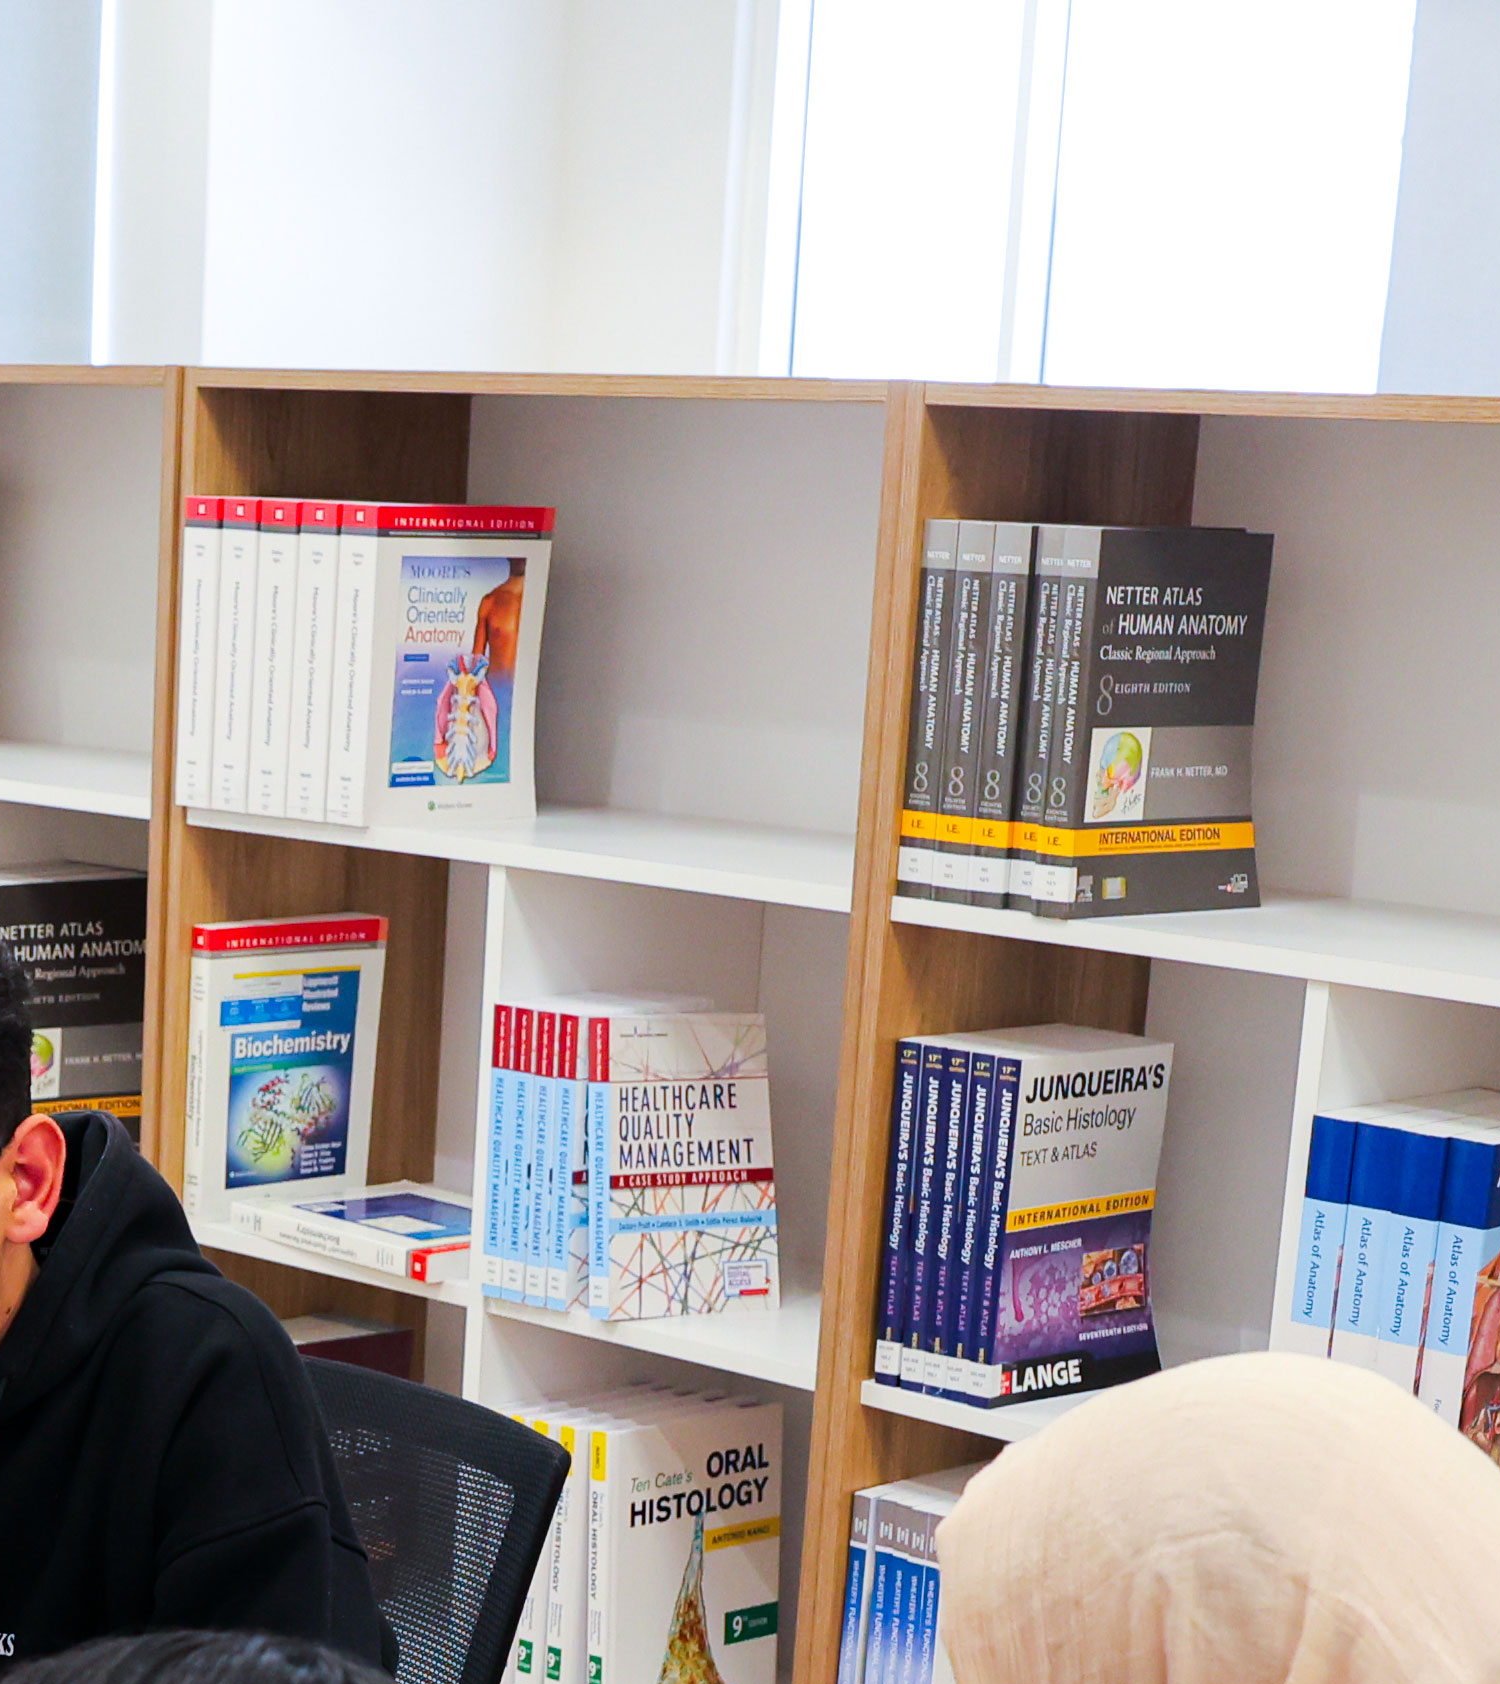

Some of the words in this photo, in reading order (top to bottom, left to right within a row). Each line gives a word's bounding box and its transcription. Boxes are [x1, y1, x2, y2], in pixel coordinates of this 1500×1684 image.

[410, 566, 471, 579] MOORE'S
[407, 587, 468, 607] Clinically
[1106, 586, 1159, 605] NETTER
[1163, 587, 1202, 605] ATLAS
[407, 606, 465, 623] Oriented
[1118, 615, 1174, 635] HUMAN
[1178, 615, 1247, 636] ANATOMY
[405, 626, 465, 647] Anatomy
[1100, 645, 1131, 660] Classic
[1135, 646, 1172, 660] Regional
[1174, 647, 1216, 661] Approach
[1097, 675, 1113, 715] 8
[1115, 682, 1150, 694] EIGHTH
[1153, 682, 1191, 693] EDITION
[1151, 766, 1173, 777] FRANK
[1099, 830, 1176, 845] INTERNATIONAL
[1179, 828, 1220, 841] EDITION
[0, 924, 54, 940] NETTER
[60, 921, 103, 937] ATLAS
[14, 943, 75, 962] HUMAN
[81, 940, 146, 958] ANATOM
[234, 1030, 350, 1060] Biochemistry
[1026, 1064, 1164, 1103] JUNQUEIRA'S
[619, 1083, 737, 1112] HEALTHCARE
[619, 1113, 695, 1141] QUALITY
[1023, 1112, 1062, 1136] Basic
[1066, 1105, 1136, 1133] Histology
[619, 1139, 754, 1169] MANAGEMENT
[1020, 1149, 1049, 1167] TEXT
[1051, 1148, 1059, 1162] &
[1062, 1142, 1097, 1159] ATLAS
[619, 1177, 625, 1186] A
[629, 1175, 651, 1186] CASE
[656, 1173, 687, 1185] STUDY
[691, 1171, 747, 1183] APPROACH
[1013, 1202, 1101, 1226] INTERNATIONAL
[1106, 1195, 1149, 1212] EDITION
[1011, 1360, 1082, 1394] LANGE
[707, 1443, 769, 1478] ORAL
[631, 1477, 651, 1494] Ten
[655, 1469, 692, 1489] Cate's
[630, 1477, 768, 1528] HISTOLOGY
